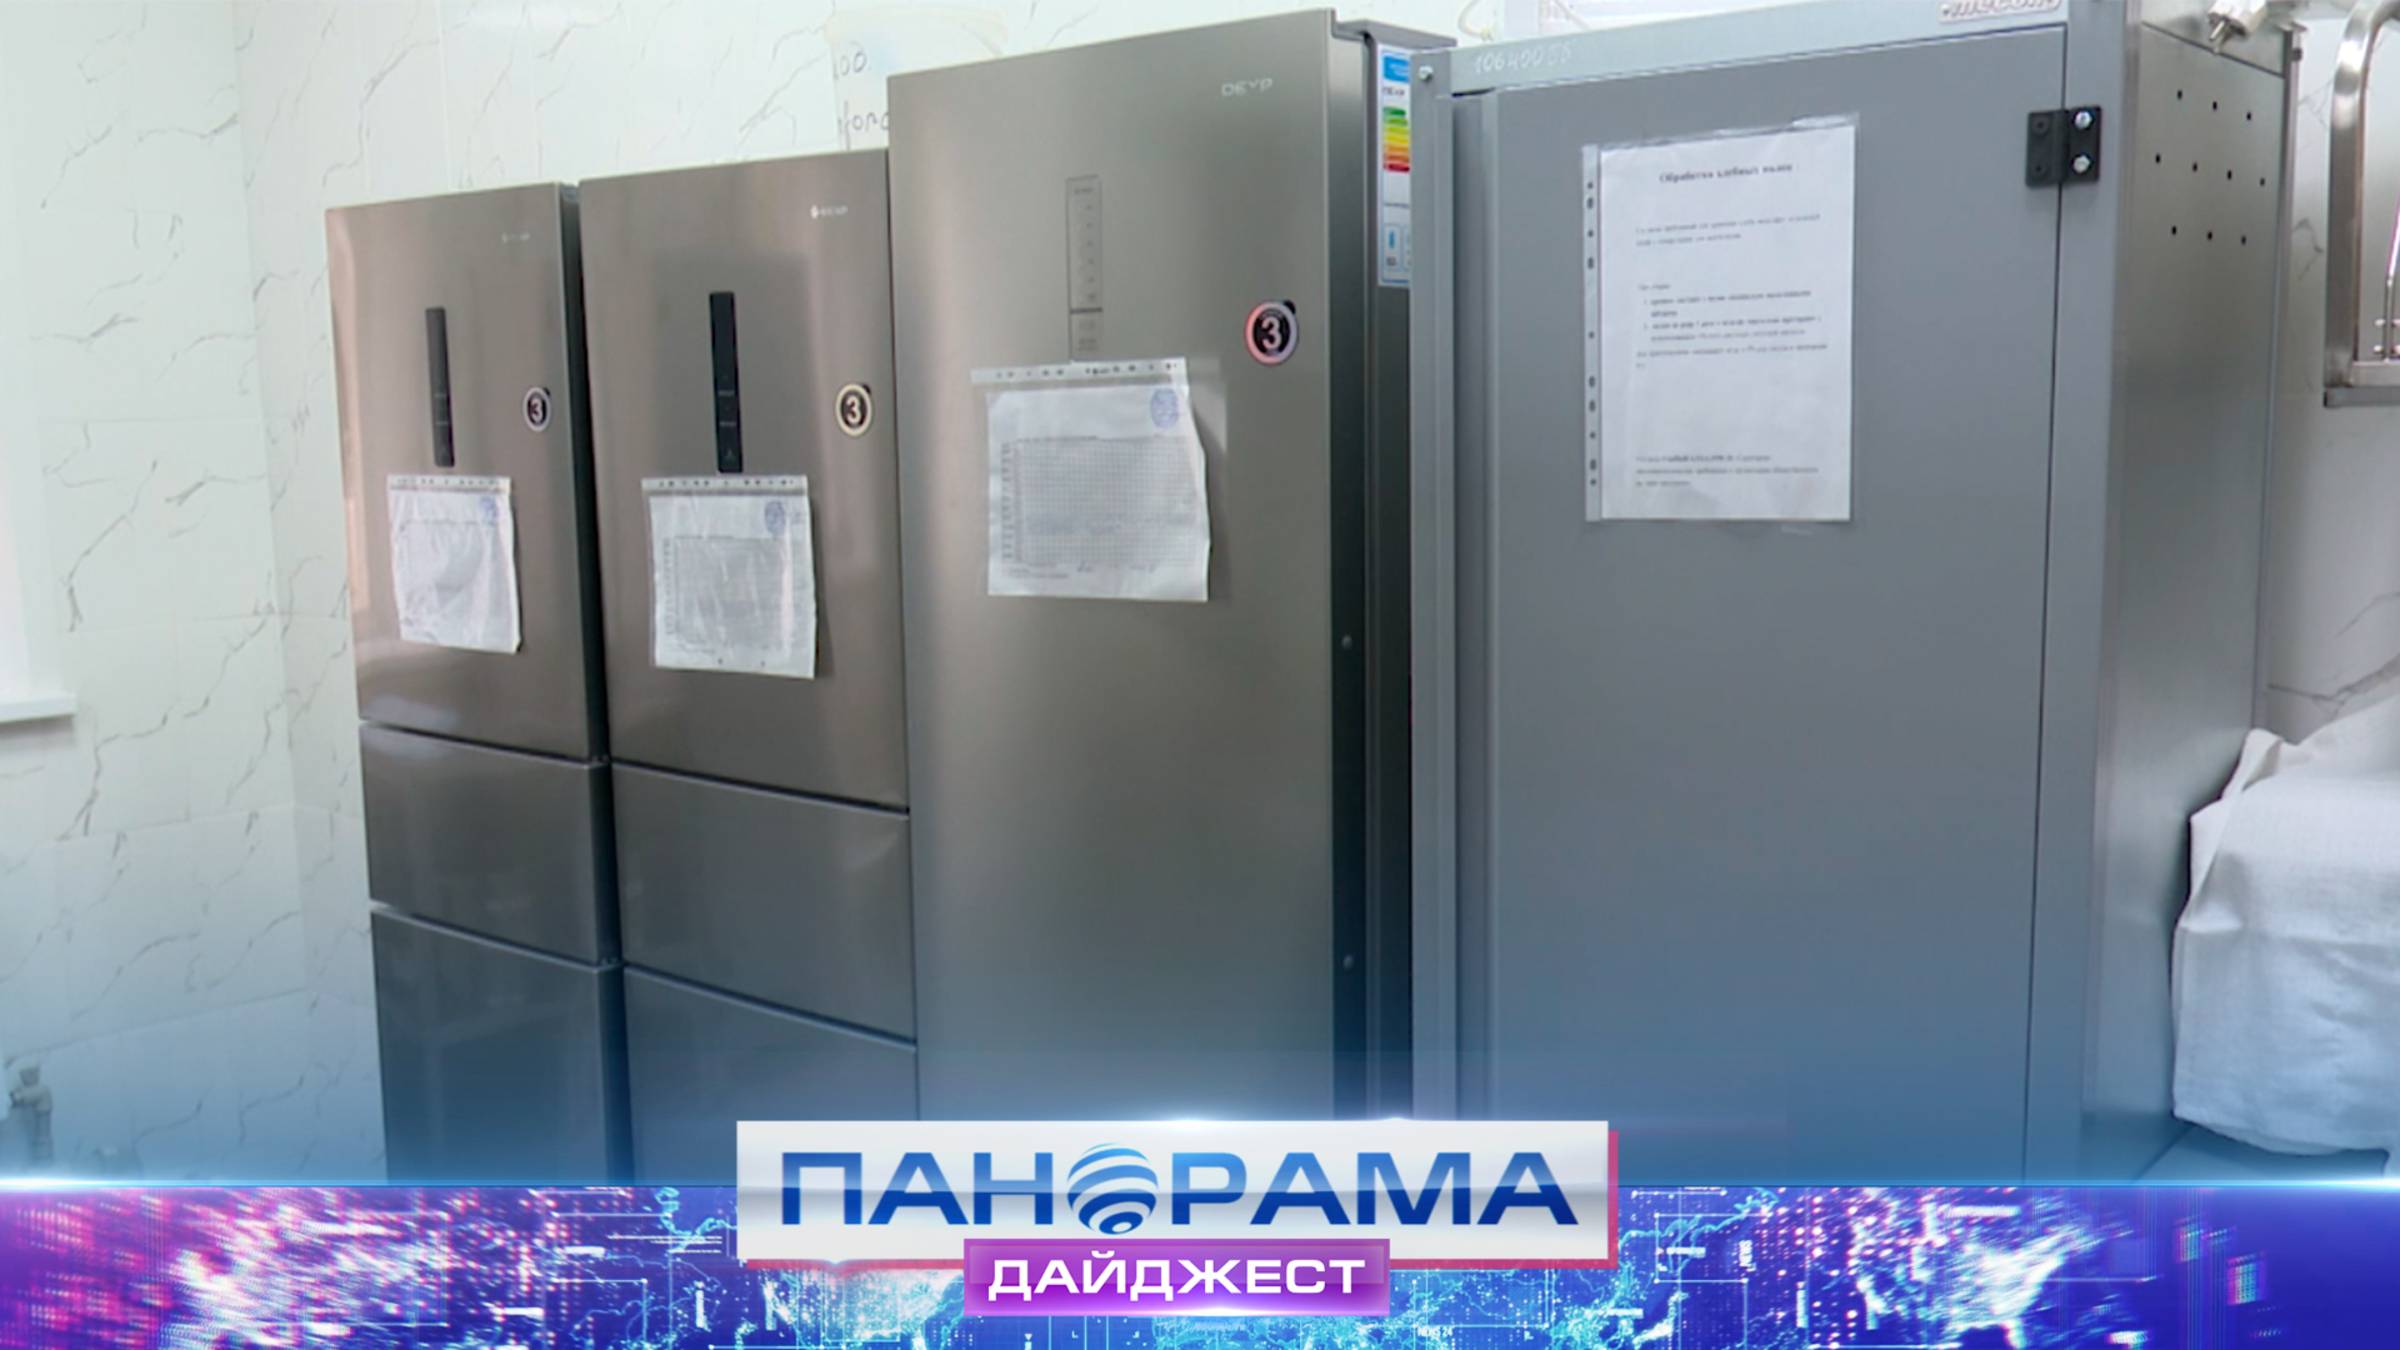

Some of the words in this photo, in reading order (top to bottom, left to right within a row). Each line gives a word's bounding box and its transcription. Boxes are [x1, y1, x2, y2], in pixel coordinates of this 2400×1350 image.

[1261, 316, 1282, 350] 3
[531, 398, 543, 422] 3
[846, 395, 861, 424] 3
